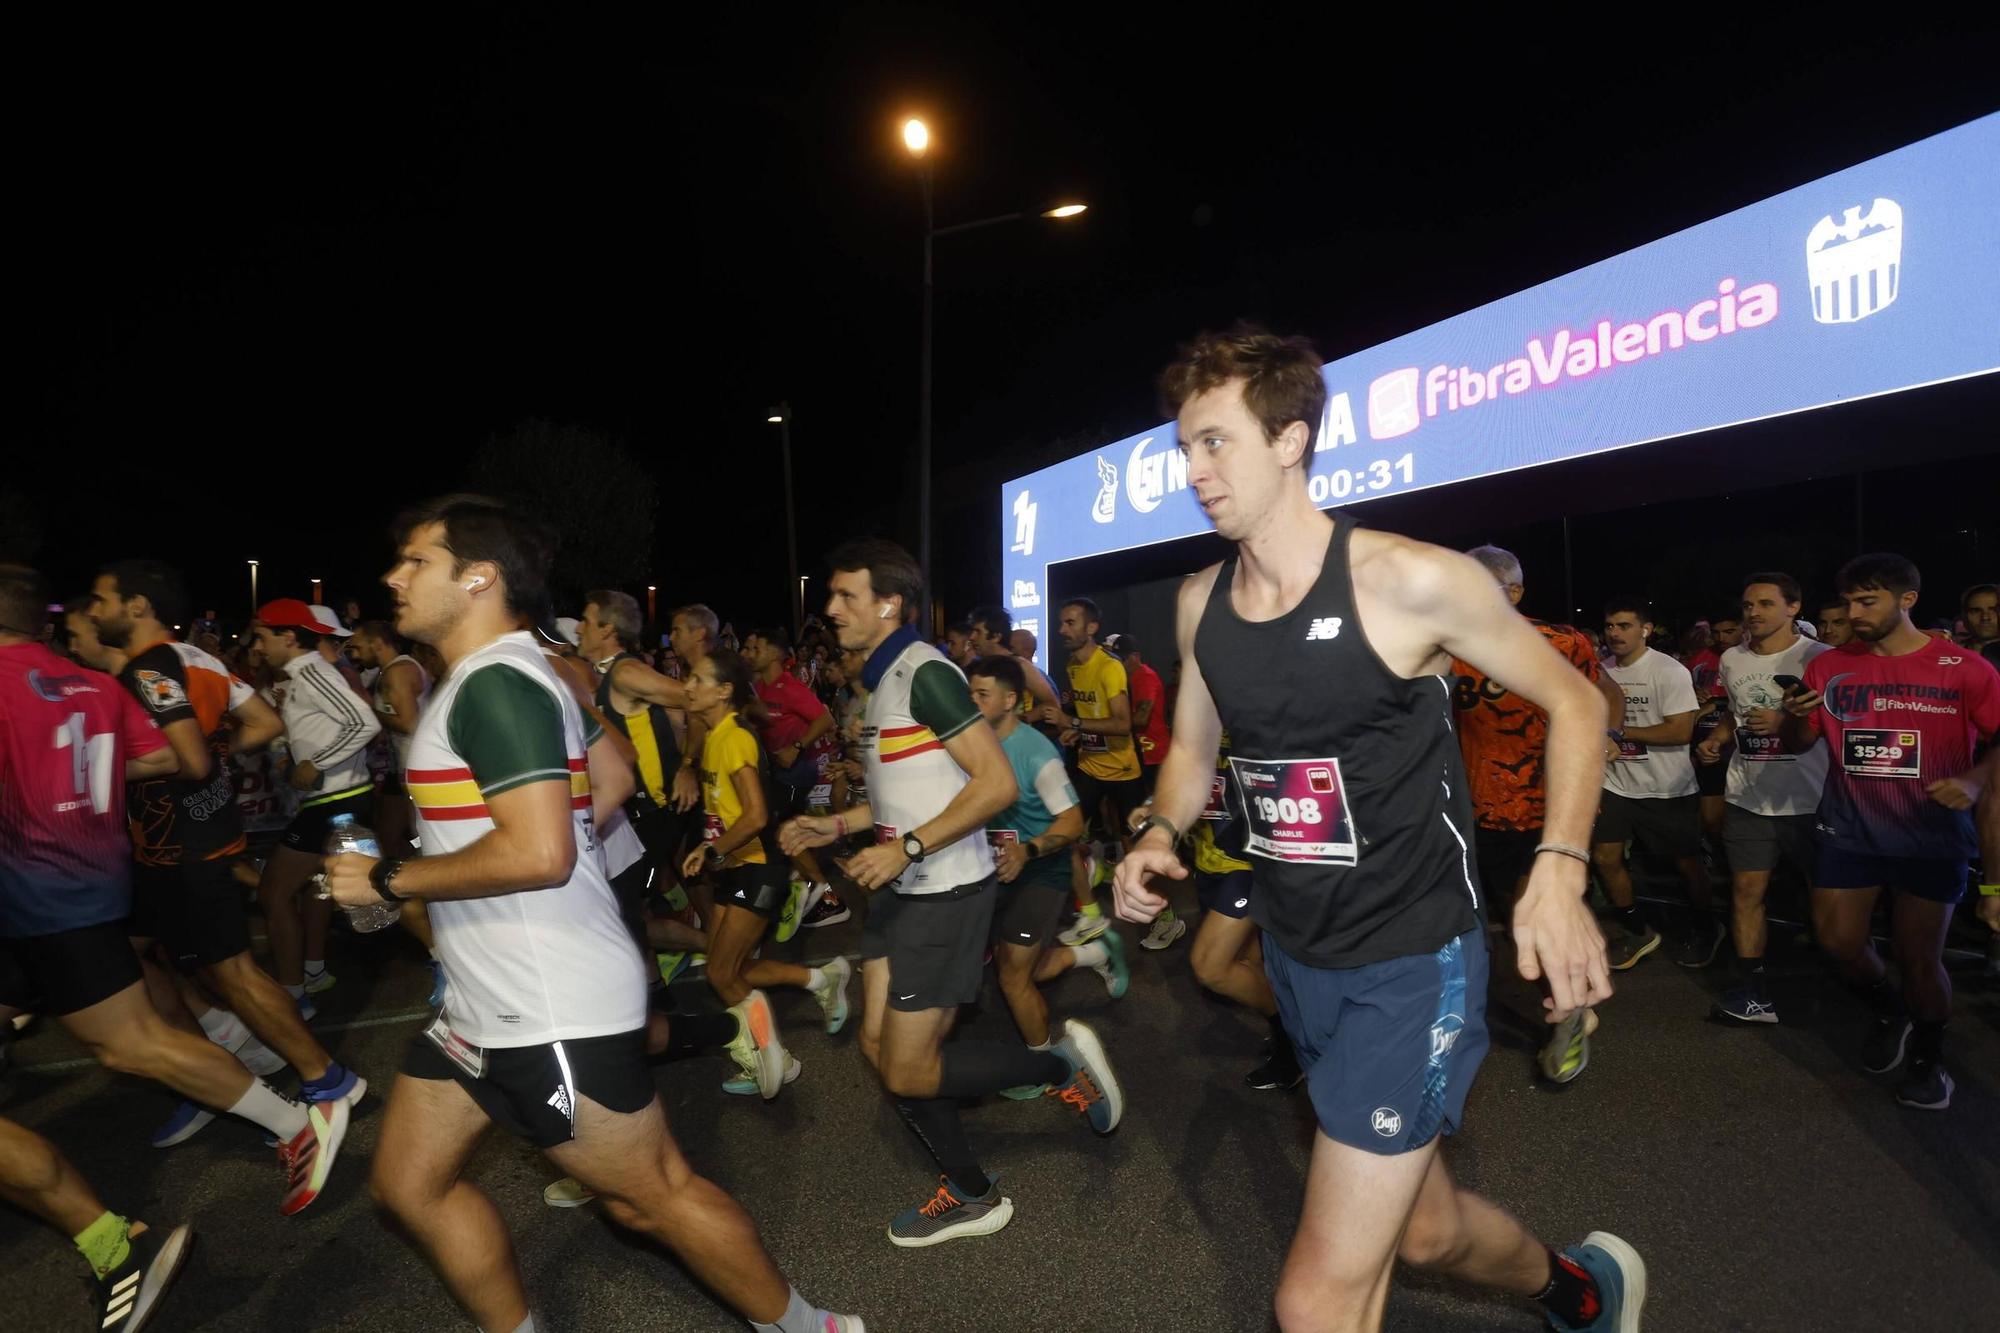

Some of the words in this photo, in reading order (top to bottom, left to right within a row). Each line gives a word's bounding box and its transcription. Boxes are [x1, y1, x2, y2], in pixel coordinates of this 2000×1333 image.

[1854, 745, 1903, 760] 3529
[1254, 795, 1322, 825] 1908
[1272, 829, 1305, 839] CHARLIE
[557, 1084, 571, 1120] adidas
[1375, 1111, 1399, 1133] Buff
